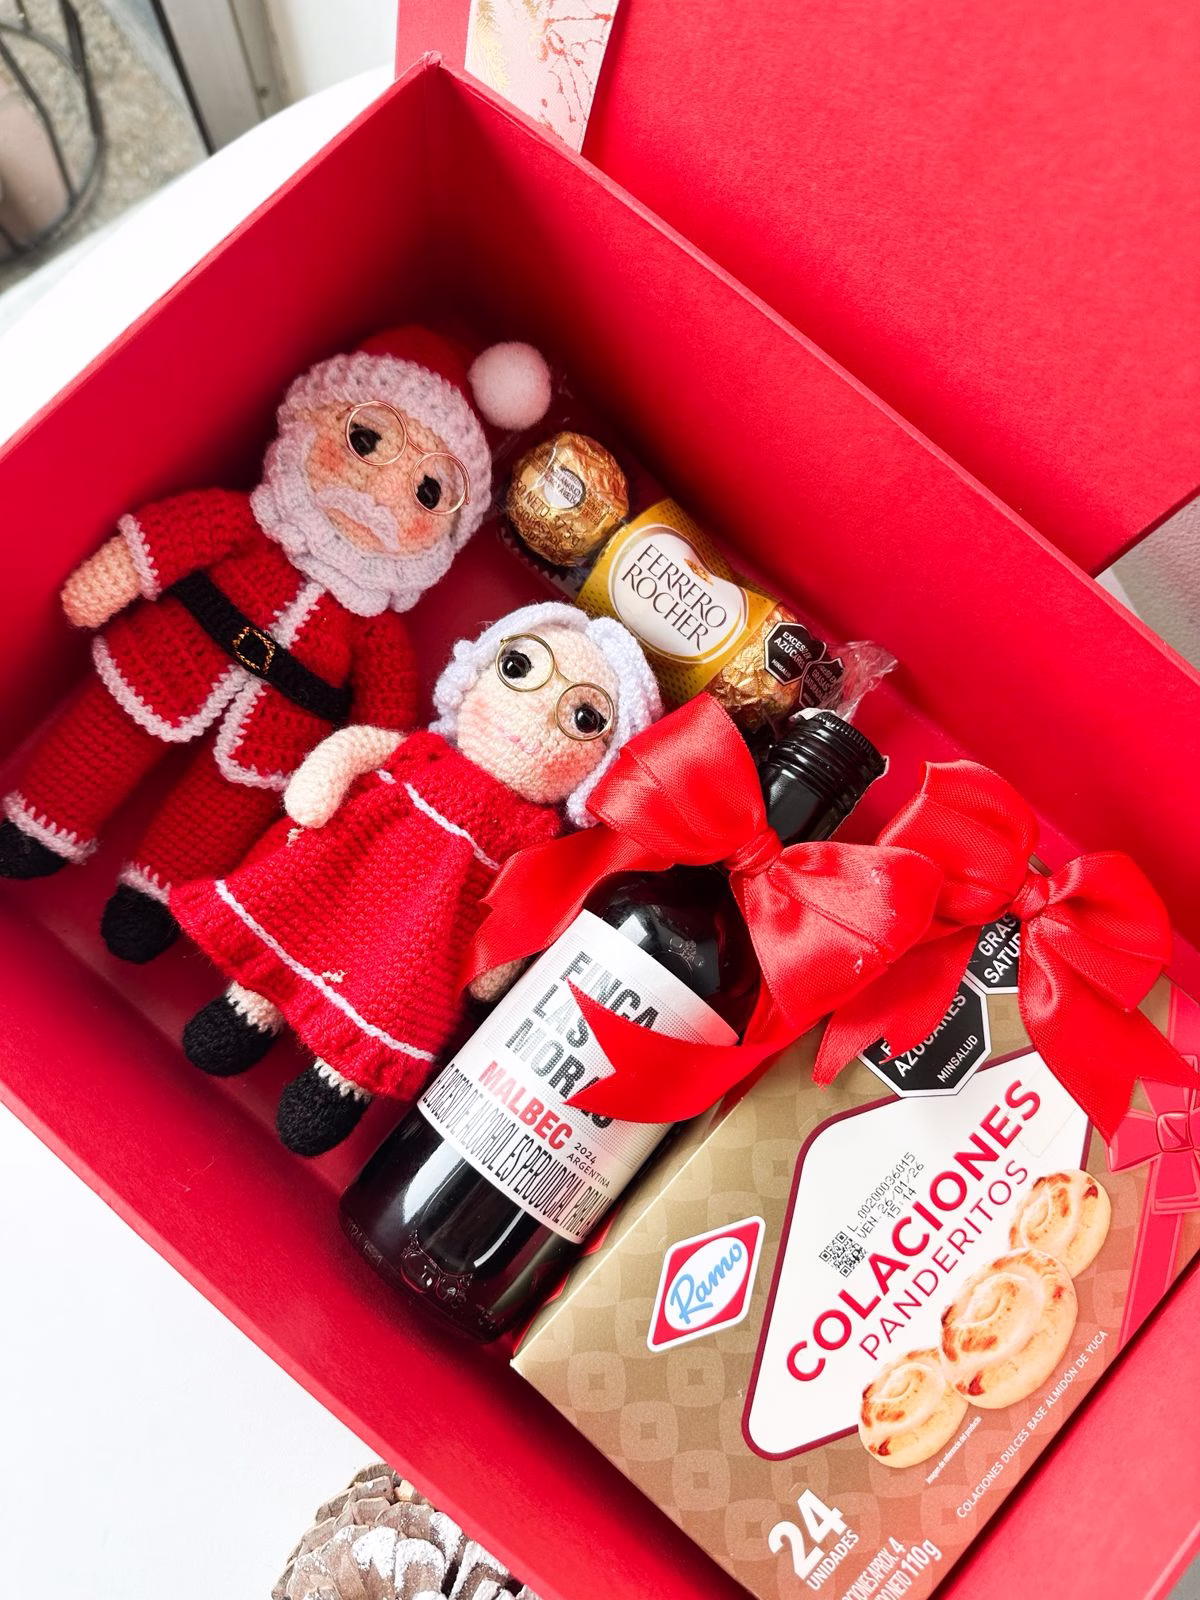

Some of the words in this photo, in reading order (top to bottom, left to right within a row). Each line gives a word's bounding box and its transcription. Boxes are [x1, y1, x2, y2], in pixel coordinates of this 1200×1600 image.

[621, 563, 709, 651] ROCHER
[637, 544, 727, 628] FERRERO
[978, 914, 1017, 957] GRAS
[532, 983, 590, 1049] LAS
[505, 1017, 614, 1129] MOR
[936, 1033, 978, 1083] MINSALUD
[426, 1067, 473, 1124] EXCESO
[445, 1088, 485, 1136] DE
[478, 1060, 573, 1150] MALBEC
[455, 1099, 520, 1171] ALCOHOL
[494, 1133, 535, 1182] ES
[573, 1142, 598, 1165] 2024
[507, 1144, 586, 1224] PERJUDICIAL
[566, 1153, 611, 1189] ARGENTINA
[786, 1079, 1042, 1382] COLACIONES
[858, 1159, 1029, 1361] PANDERITOS
[670, 1243, 743, 1325] Ramo
[956, 1460, 1004, 1519] COLACIONES
[1000, 1428, 1031, 1466] DULCES
[1026, 1406, 1048, 1431] BASE
[1045, 1367, 1079, 1409] ALMIDÓN
[1075, 1352, 1089, 1370] DE
[1085, 1330, 1109, 1356] YUCA
[767, 1487, 848, 1581] 24
[806, 1529, 860, 1592] UNIDADES
[866, 1546, 899, 1583] APROX.
[888, 1535, 907, 1554] 4
[884, 1569, 913, 1599] NETO
